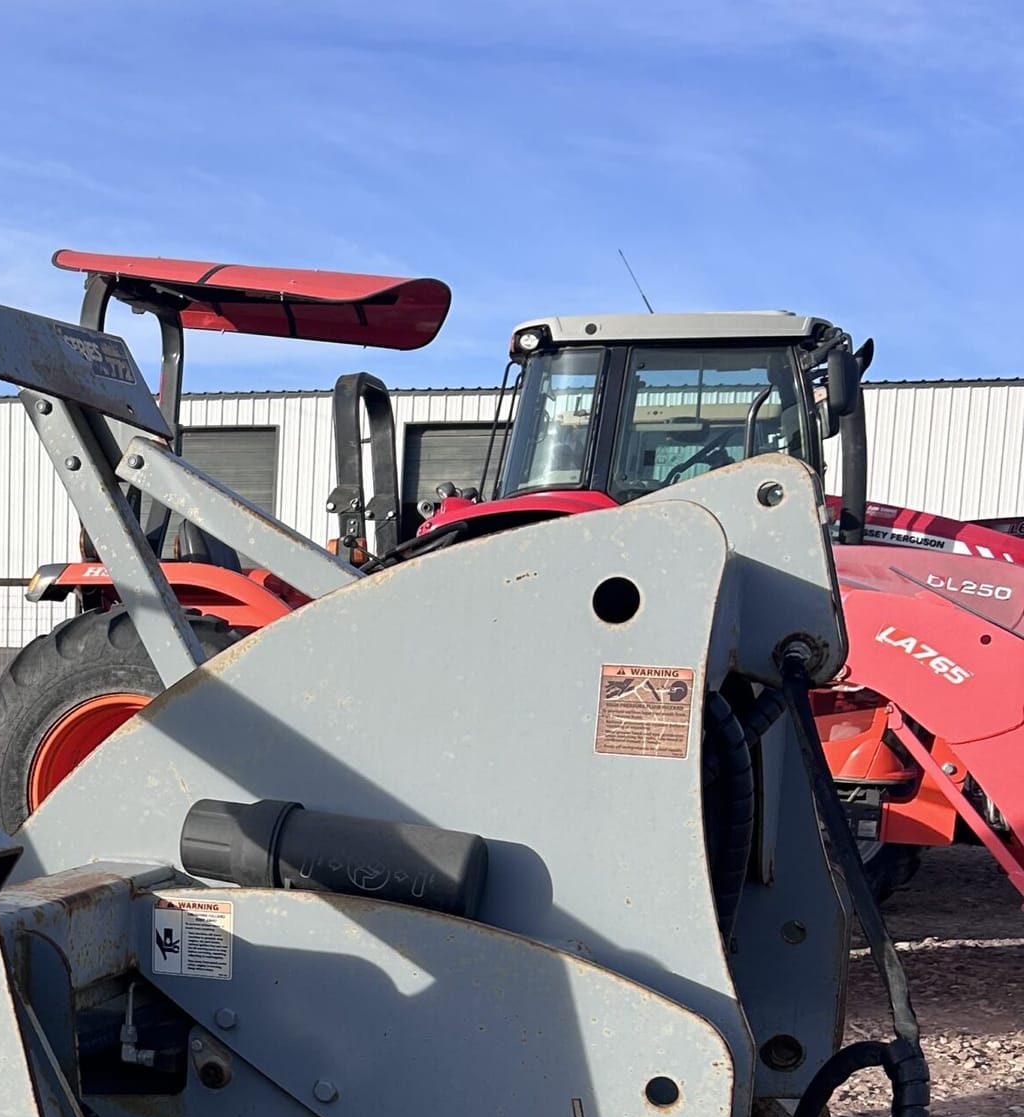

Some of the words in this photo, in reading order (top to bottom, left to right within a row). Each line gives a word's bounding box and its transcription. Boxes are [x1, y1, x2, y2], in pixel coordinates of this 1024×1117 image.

[890, 532, 946, 549] FERGUSON
[875, 626, 970, 685] LA765
[178, 902, 219, 911] WARNING
